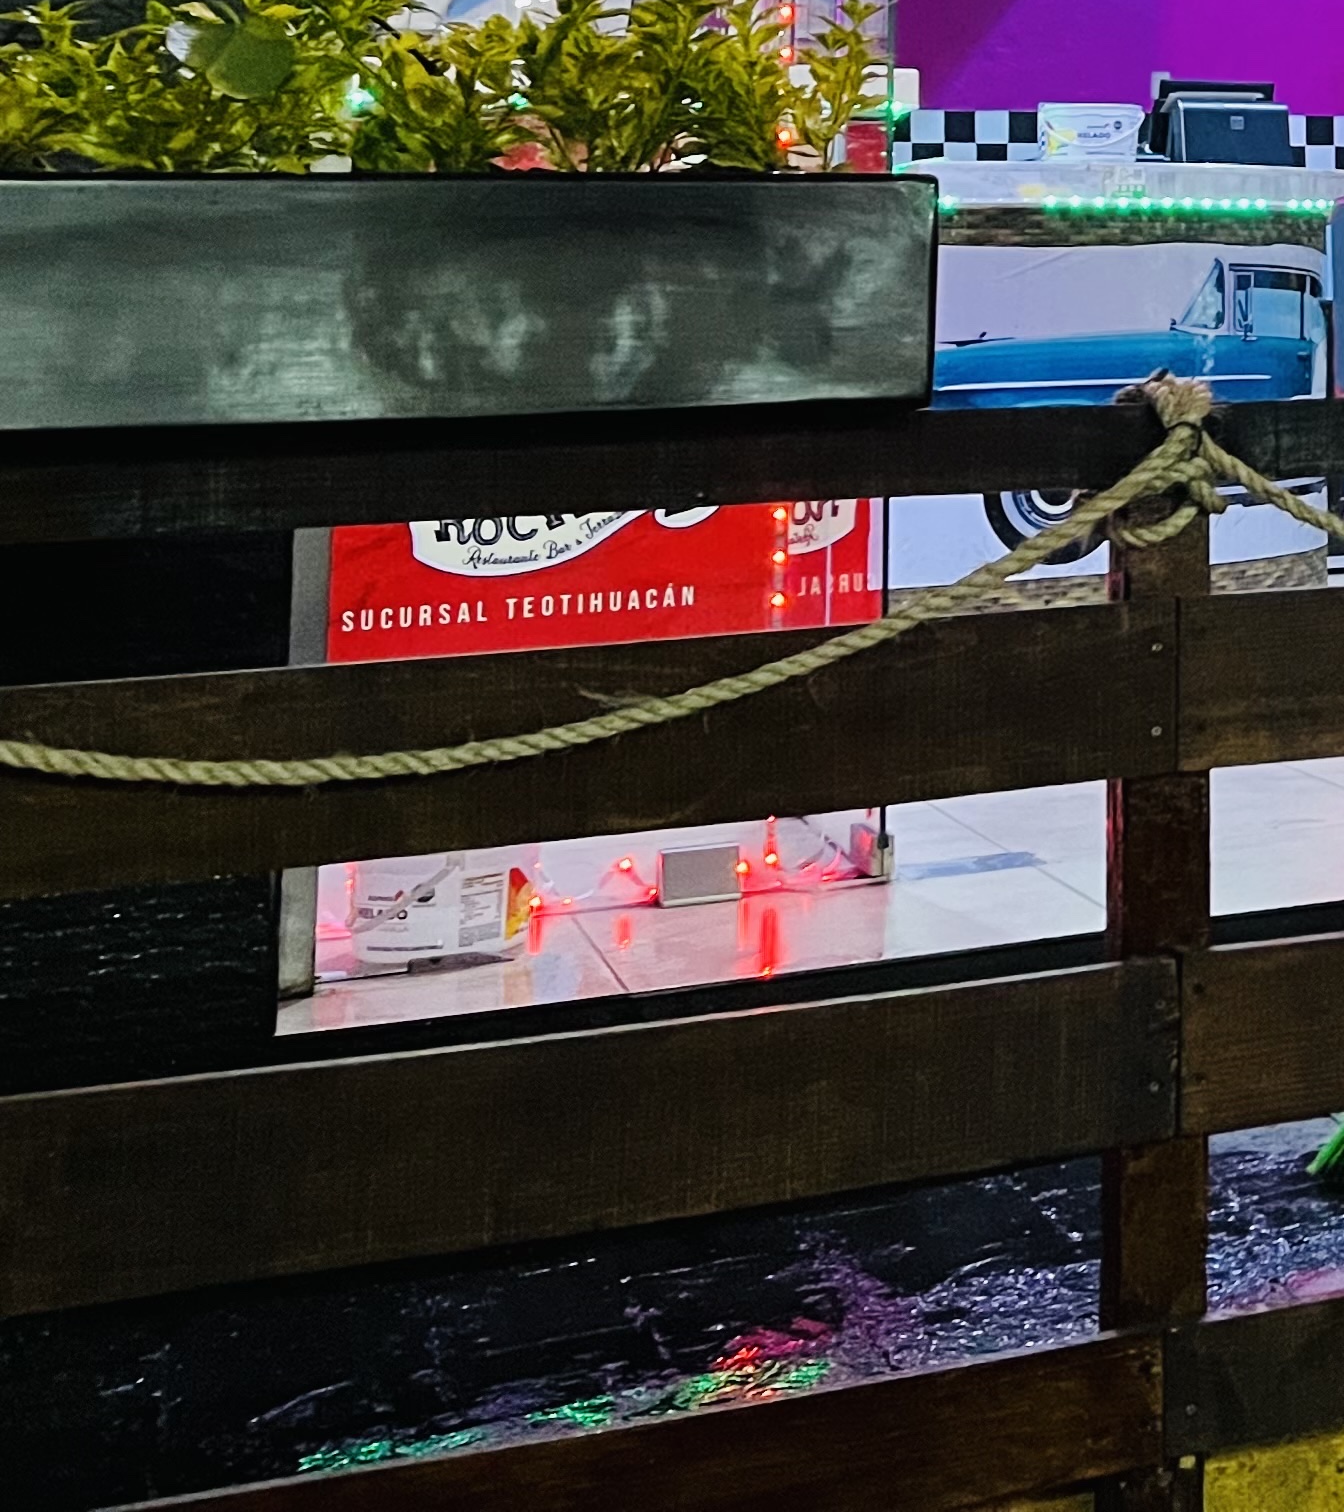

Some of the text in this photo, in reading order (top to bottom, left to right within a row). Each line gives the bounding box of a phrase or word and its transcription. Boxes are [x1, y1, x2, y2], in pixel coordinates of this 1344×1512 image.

[543, 538, 572, 560] Bar
[341, 582, 696, 633] SUCURSAL TEOTIHUACÁN
